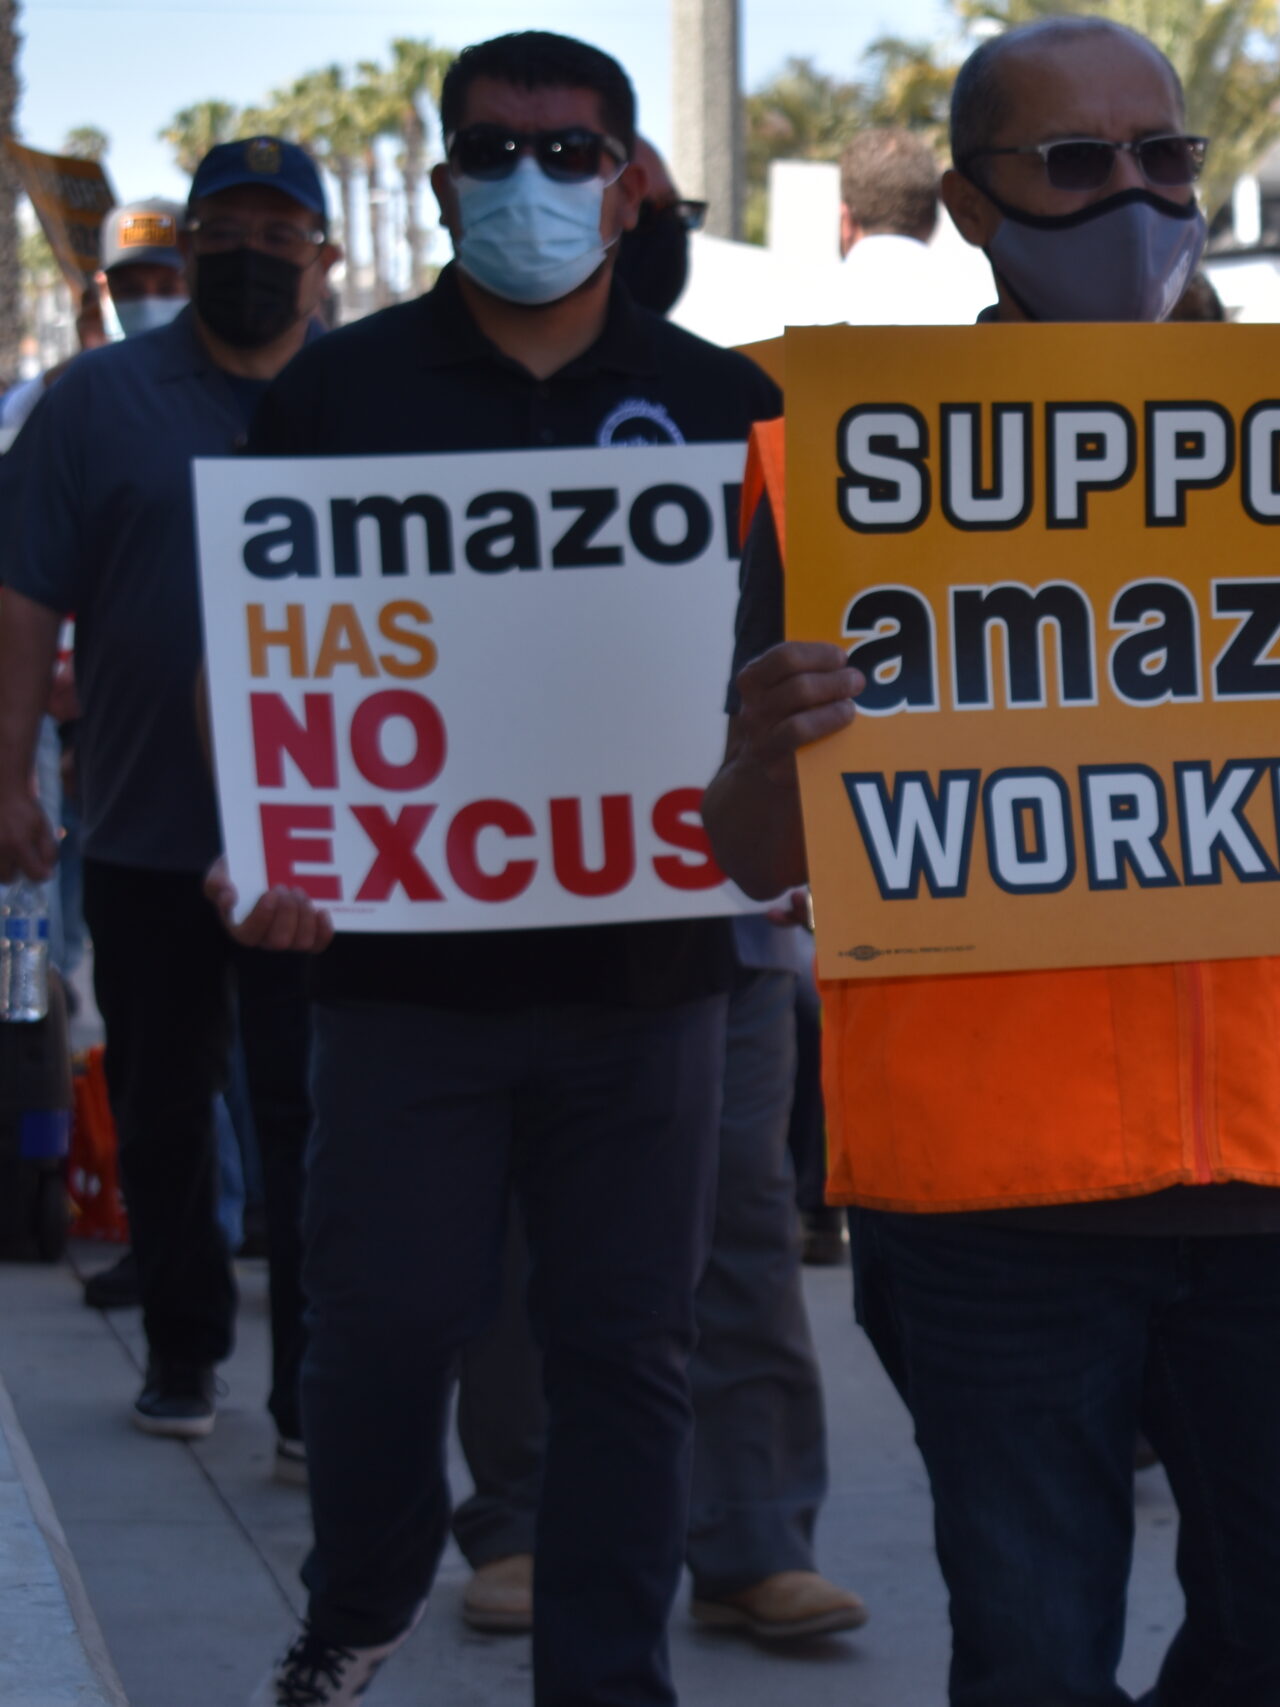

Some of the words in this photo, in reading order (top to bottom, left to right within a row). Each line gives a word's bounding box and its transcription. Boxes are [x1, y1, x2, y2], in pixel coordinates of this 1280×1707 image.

[242, 482, 744, 580] amazo
[246, 599, 438, 679] HAS
[249, 689, 448, 792] NO
[258, 788, 734, 902] EXCUS
